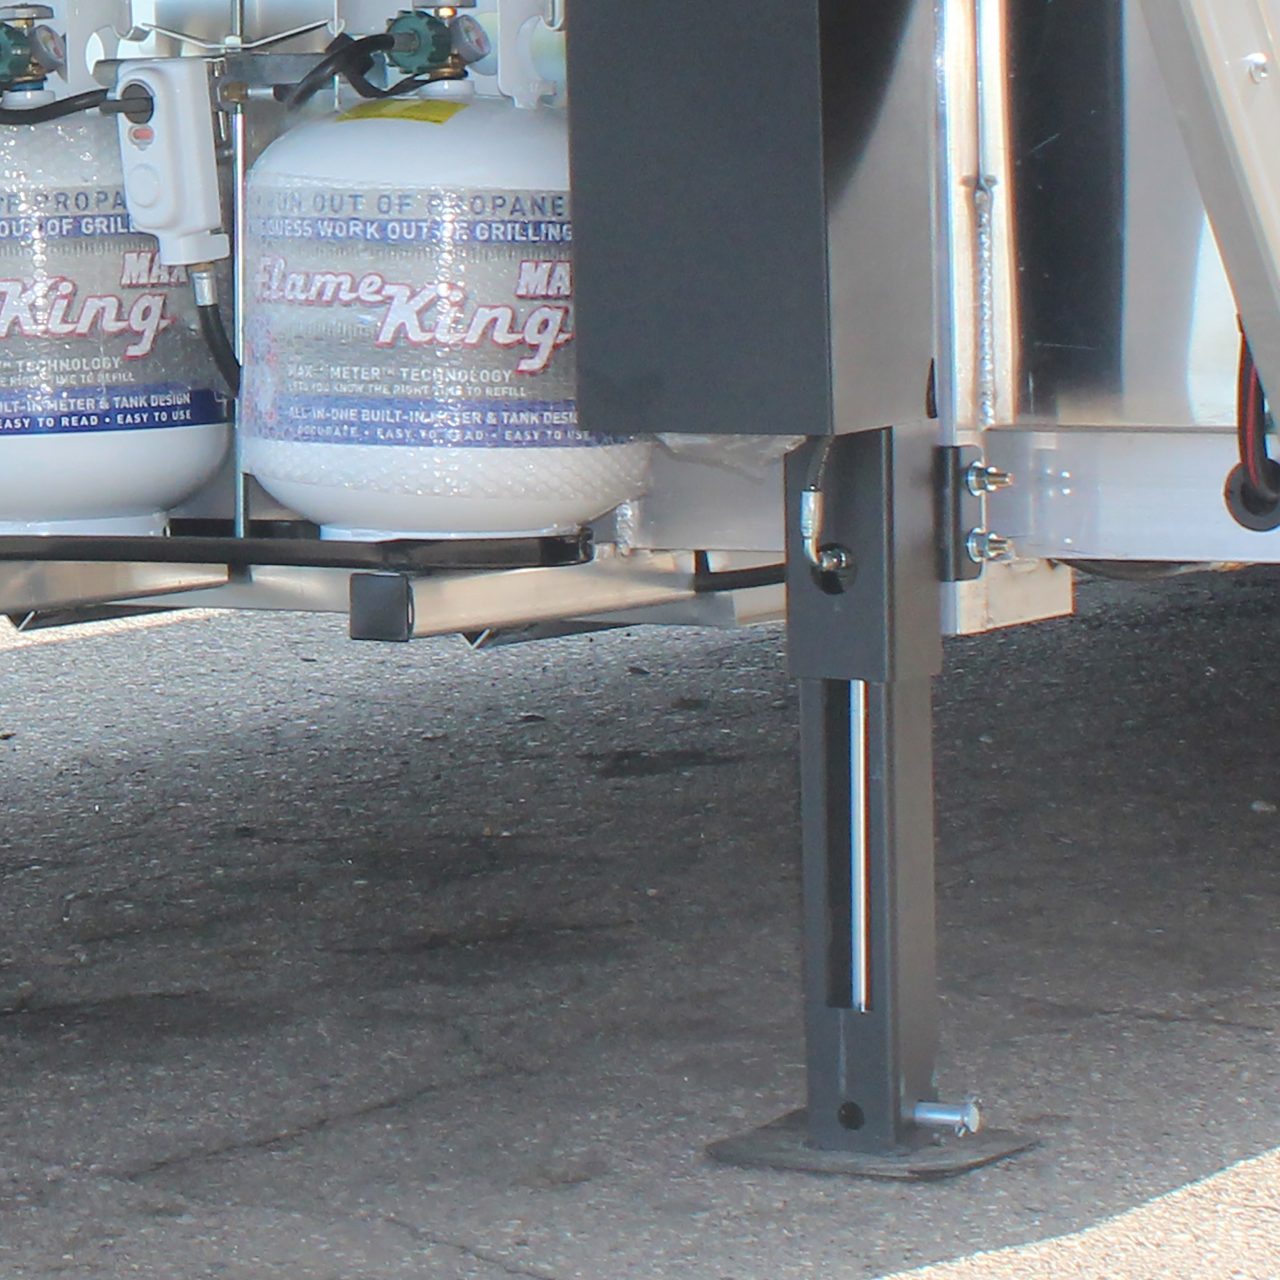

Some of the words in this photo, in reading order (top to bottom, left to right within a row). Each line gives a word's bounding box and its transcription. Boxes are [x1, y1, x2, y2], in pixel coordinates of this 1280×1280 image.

[34, 190, 127, 213] PROPA
[313, 194, 363, 214] OUT
[377, 194, 413, 214] OF
[47, 218, 74, 236] OF
[81, 215, 136, 234] GRILL
[317, 221, 380, 240] WORK
[387, 222, 429, 240] OUT
[475, 222, 573, 241] GRILLING
[515, 260, 574, 298] MA
[374, 282, 574, 373] King
[15, 356, 121, 374] TECHNOLOGY
[400, 367, 512, 382] TECHNOLOGY
[367, 384, 391, 395] THE
[467, 386, 481, 396] TO
[486, 386, 527, 397] REFILL
[113, 395, 148, 408] TANK
[150, 392, 191, 407] DESIGN
[36, 417, 55, 427] TO
[61, 415, 98, 426] READ
[117, 413, 149, 424] EASY
[154, 412, 167, 422] TO
[172, 410, 191, 420] USE
[487, 412, 498, 424] &
[503, 412, 539, 424] TANK
[377, 427, 412, 440] EASY
[505, 430, 540, 441] EASY
[546, 430, 561, 440] TO
[567, 429, 591, 440] USE
